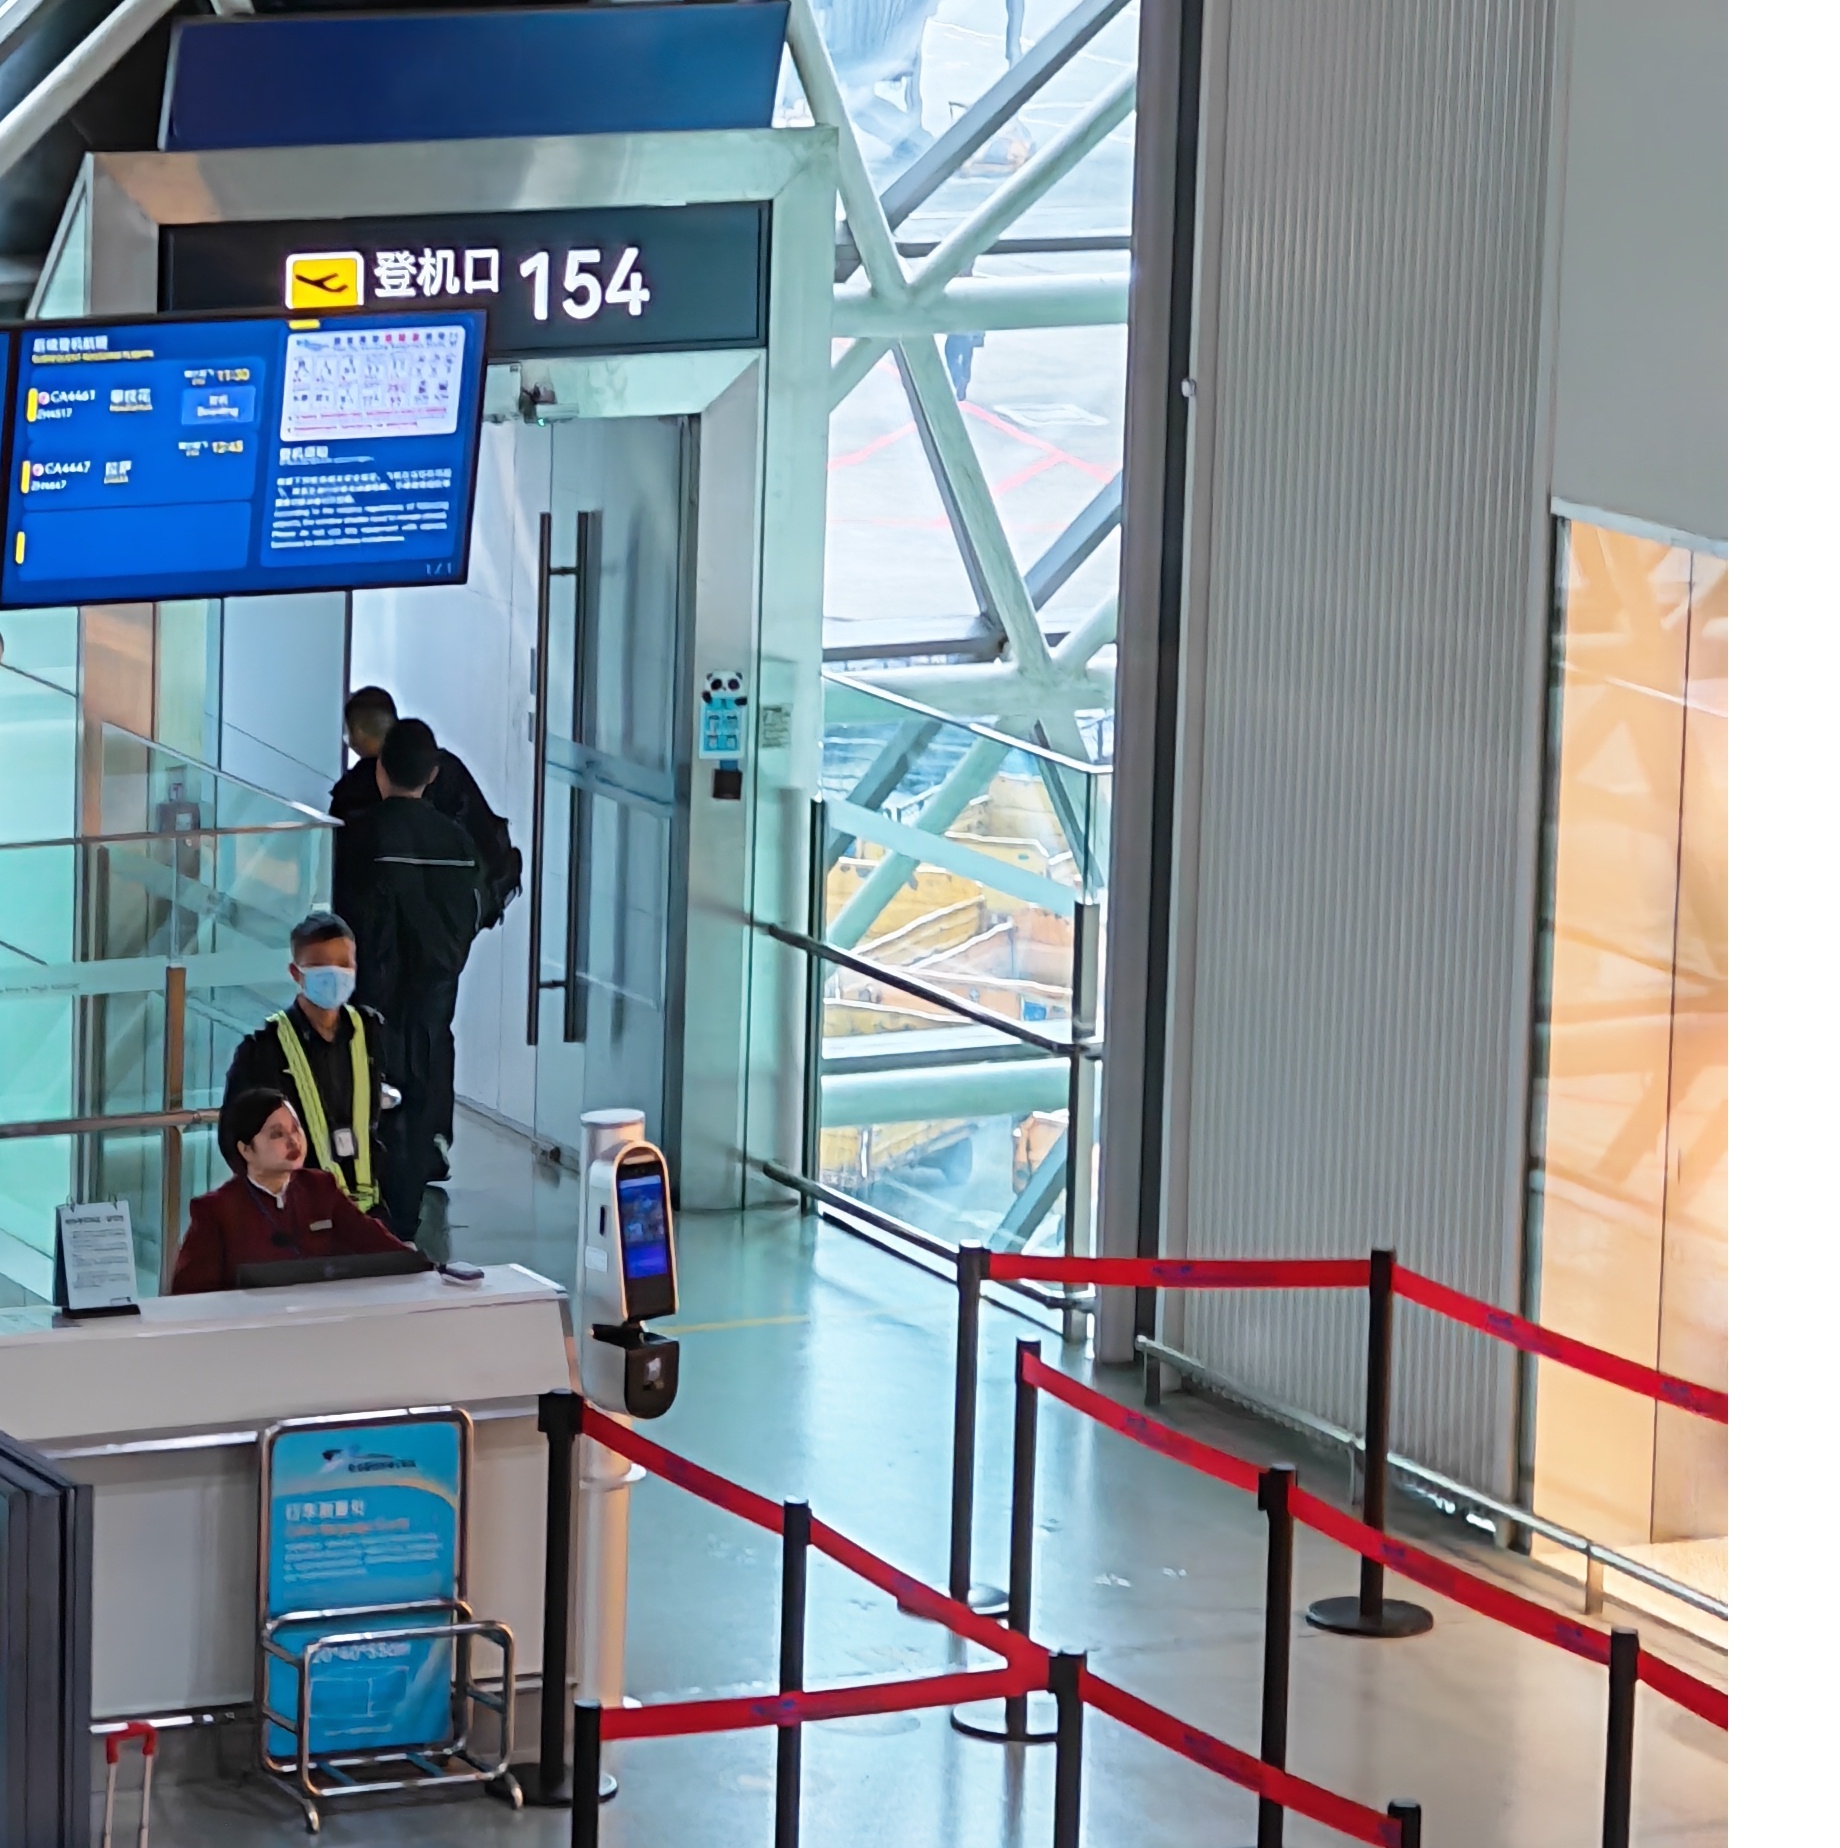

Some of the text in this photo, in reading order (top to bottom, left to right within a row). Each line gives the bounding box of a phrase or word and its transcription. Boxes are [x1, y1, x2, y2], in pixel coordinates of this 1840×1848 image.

[373, 246, 651, 321] 登机口 154
